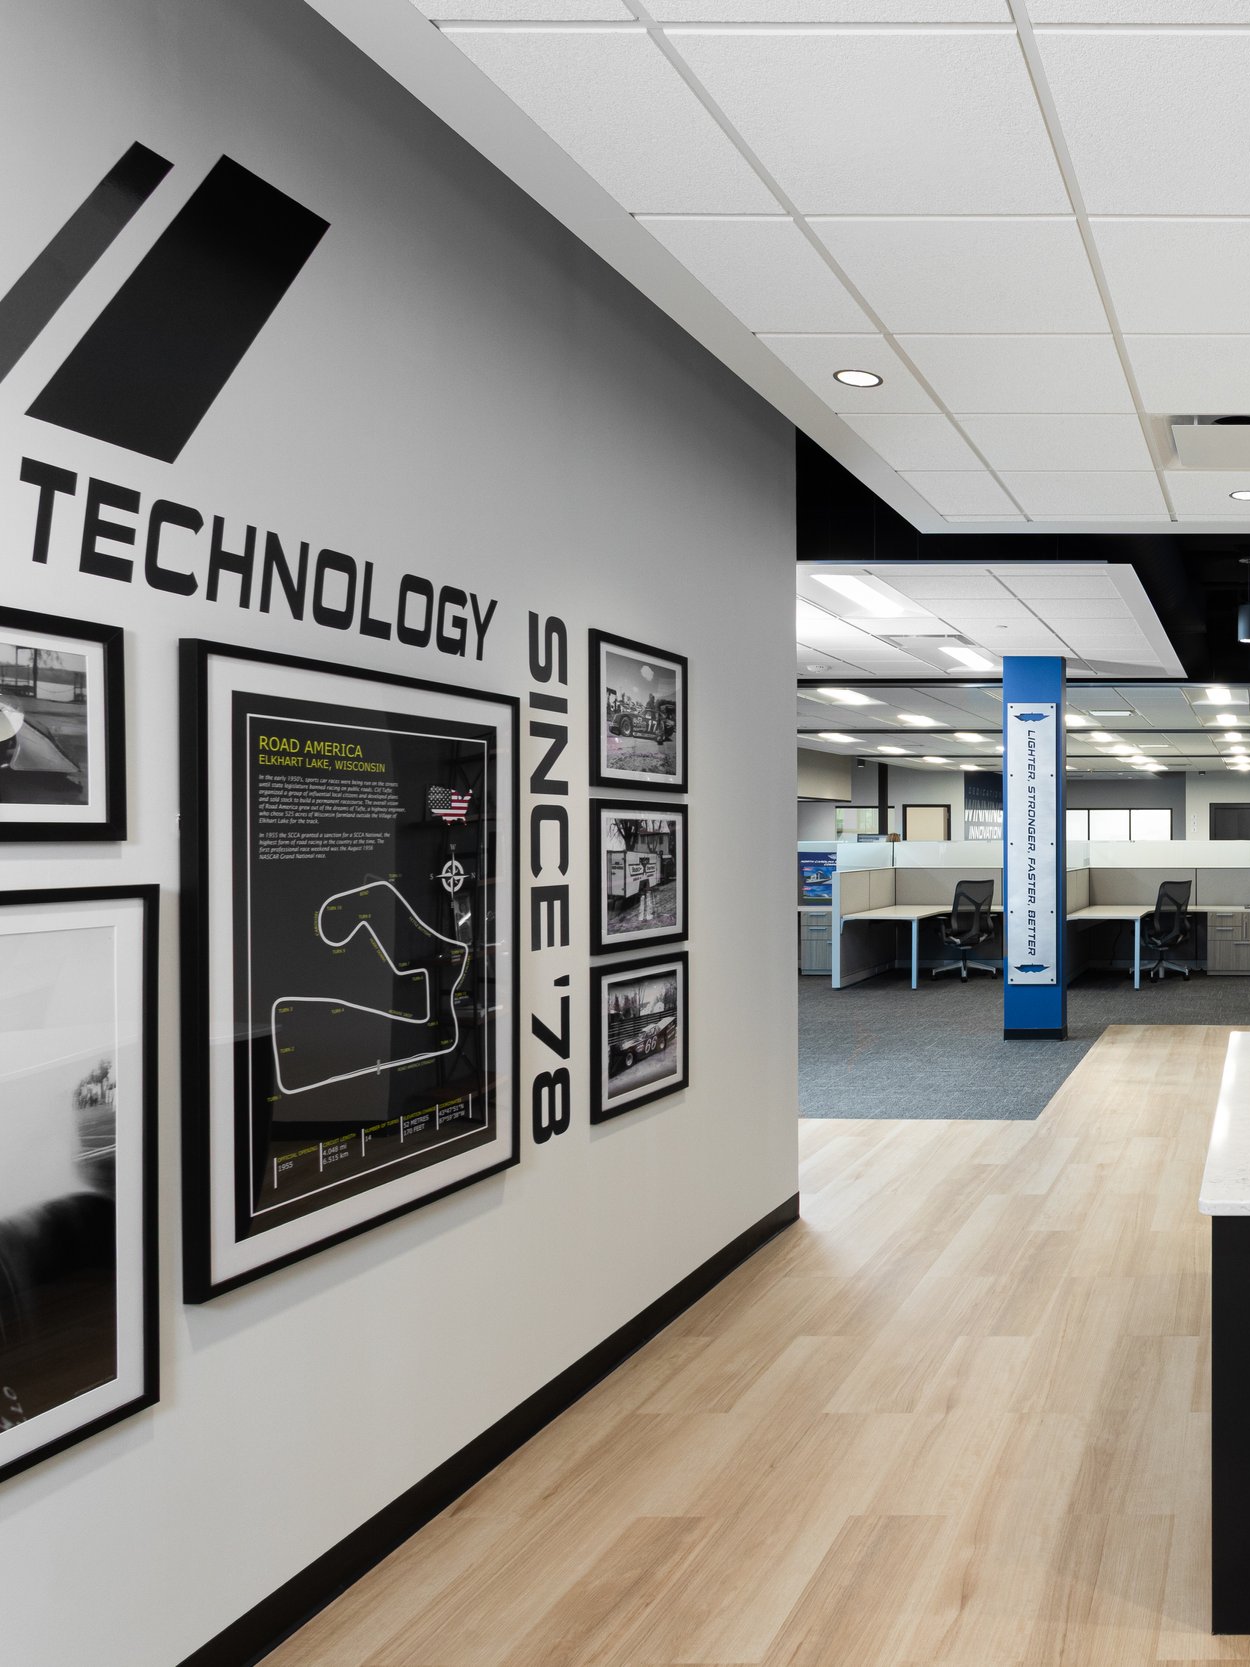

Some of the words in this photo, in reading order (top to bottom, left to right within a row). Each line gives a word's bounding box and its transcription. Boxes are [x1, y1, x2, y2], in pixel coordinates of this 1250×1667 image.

[20, 457, 498, 660] TECHNOLOGY
[258, 754, 304, 767] ELKHART
[306, 758, 332, 771] LAKE,
[334, 760, 386, 772] WISCONSIN
[260, 736, 300, 752] ROAD
[304, 740, 363, 758] AMERICA
[1026, 730, 1036, 782] LIGHTER,
[528, 610, 570, 952] SINCE
[1026, 786, 1036, 853] STRONGER,
[1026, 857, 1036, 906] FASTER,
[1026, 910, 1036, 956] BETTER
[530, 976, 572, 1145] '78
[645, 1036, 658, 1054] 66
[365, 1134, 372, 1142] 14
[278, 1160, 294, 1172] 1955
